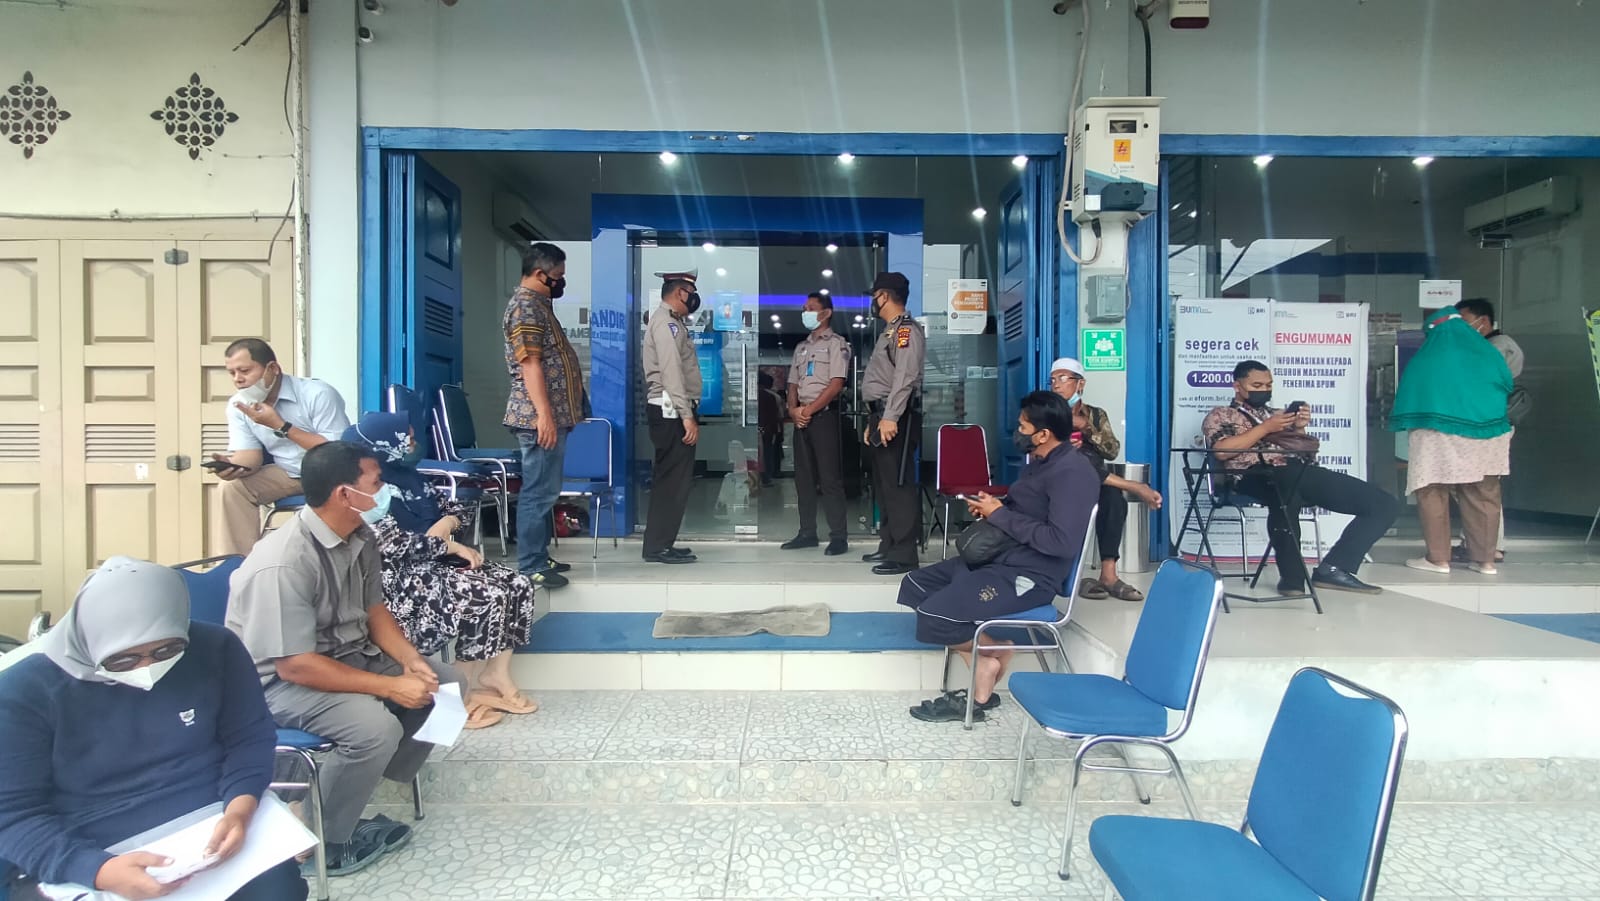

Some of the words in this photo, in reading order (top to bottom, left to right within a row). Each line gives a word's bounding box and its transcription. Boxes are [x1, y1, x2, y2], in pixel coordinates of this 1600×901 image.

[1275, 332, 1352, 344] ENGUMUMAN
[1185, 340, 1231, 353] segera
[1235, 337, 1260, 351] cek
[1273, 356, 1325, 365] INFORMASIKAN
[1326, 357, 1352, 365] KEPADA
[1273, 367, 1302, 376] SELURUH
[1302, 368, 1346, 377] MASYARAKAT
[1283, 379, 1315, 388] PENERIMA
[1310, 404, 1324, 414] ANK
[1319, 418, 1352, 428] PUNGUTAN
[1317, 456, 1330, 464] PAT
[1331, 456, 1352, 465] PIHAK
